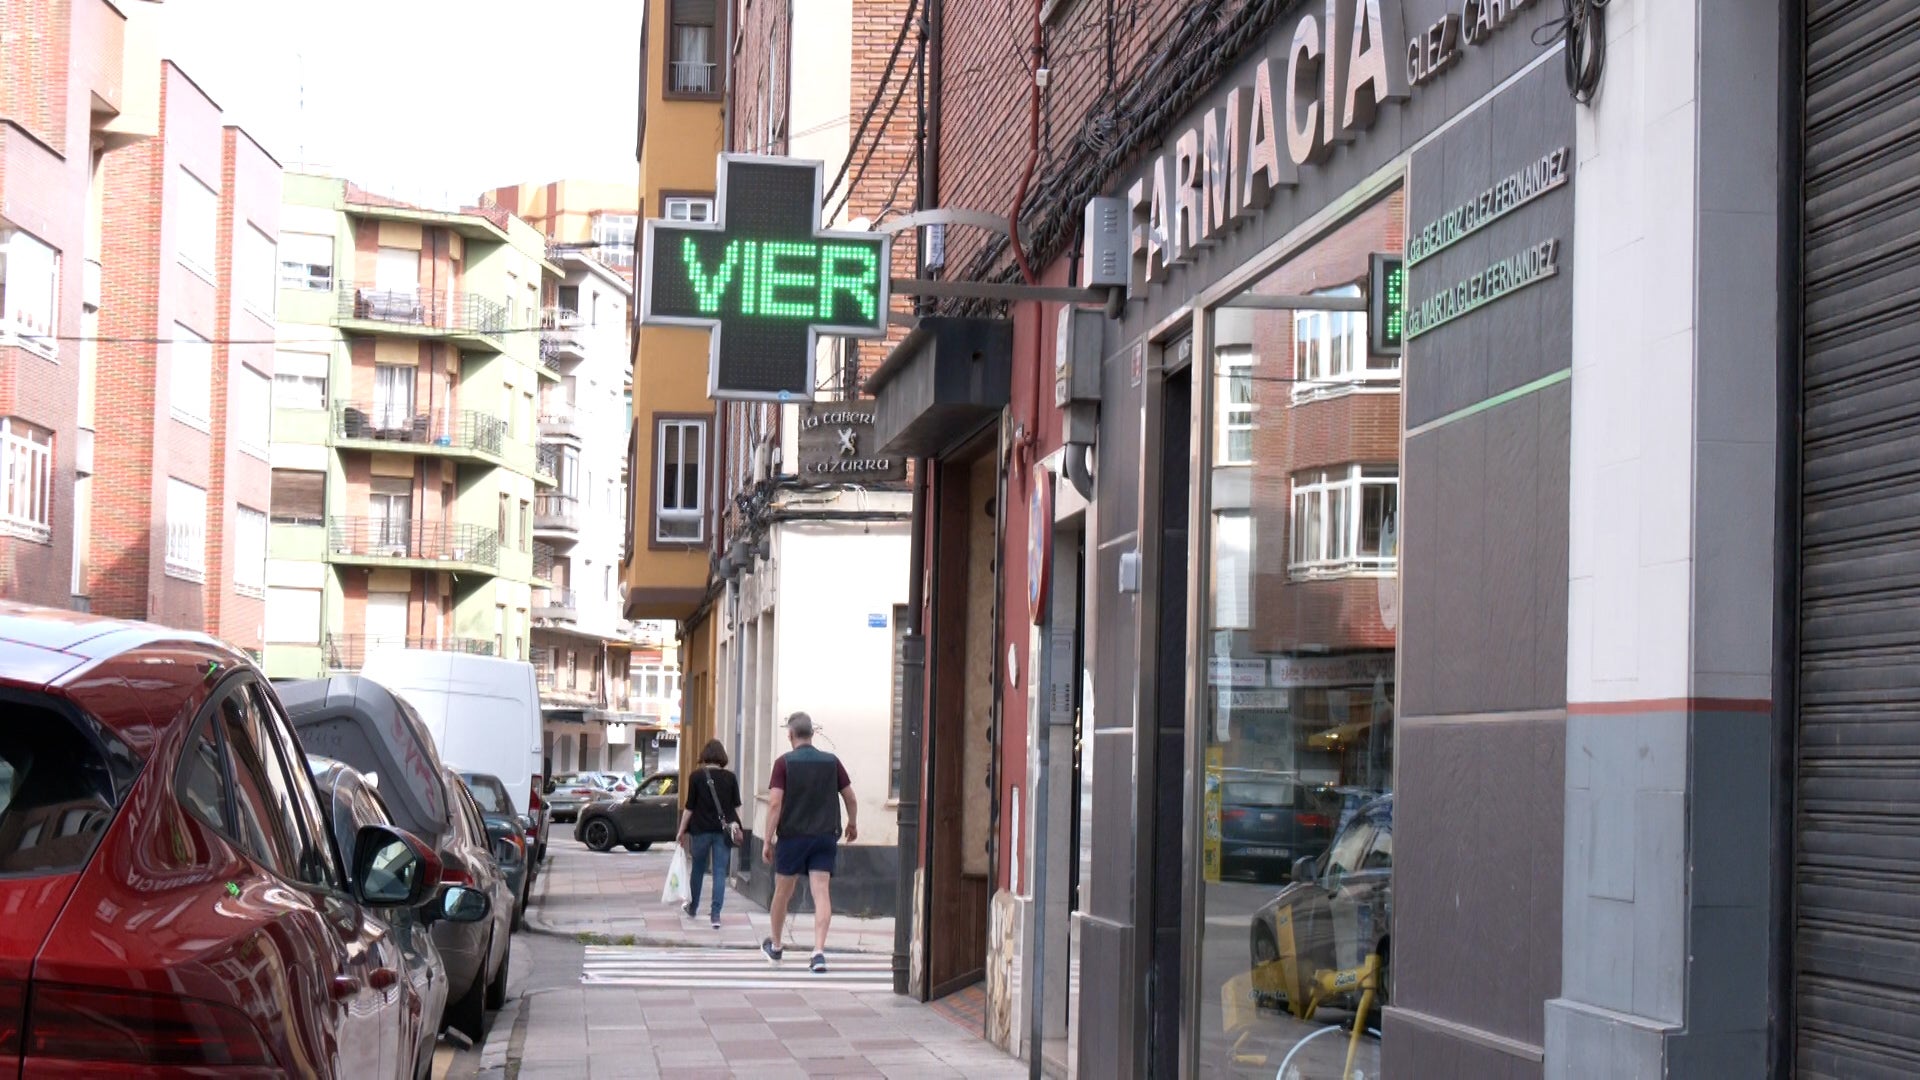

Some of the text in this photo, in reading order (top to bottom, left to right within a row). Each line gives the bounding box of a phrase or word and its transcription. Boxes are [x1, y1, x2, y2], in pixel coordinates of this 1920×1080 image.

[1127, 0, 1388, 299] FARMACIA
[1423, 205, 1464, 252] BEATRIZ
[1465, 188, 1493, 227] GLEZ
[1495, 147, 1567, 212] FERNANDEZ
[683, 237, 877, 320] VIER
[1422, 288, 1455, 328] MARTA
[1456, 272, 1485, 310] GLEZ
[1486, 238, 1554, 296] FERNANDEZ
